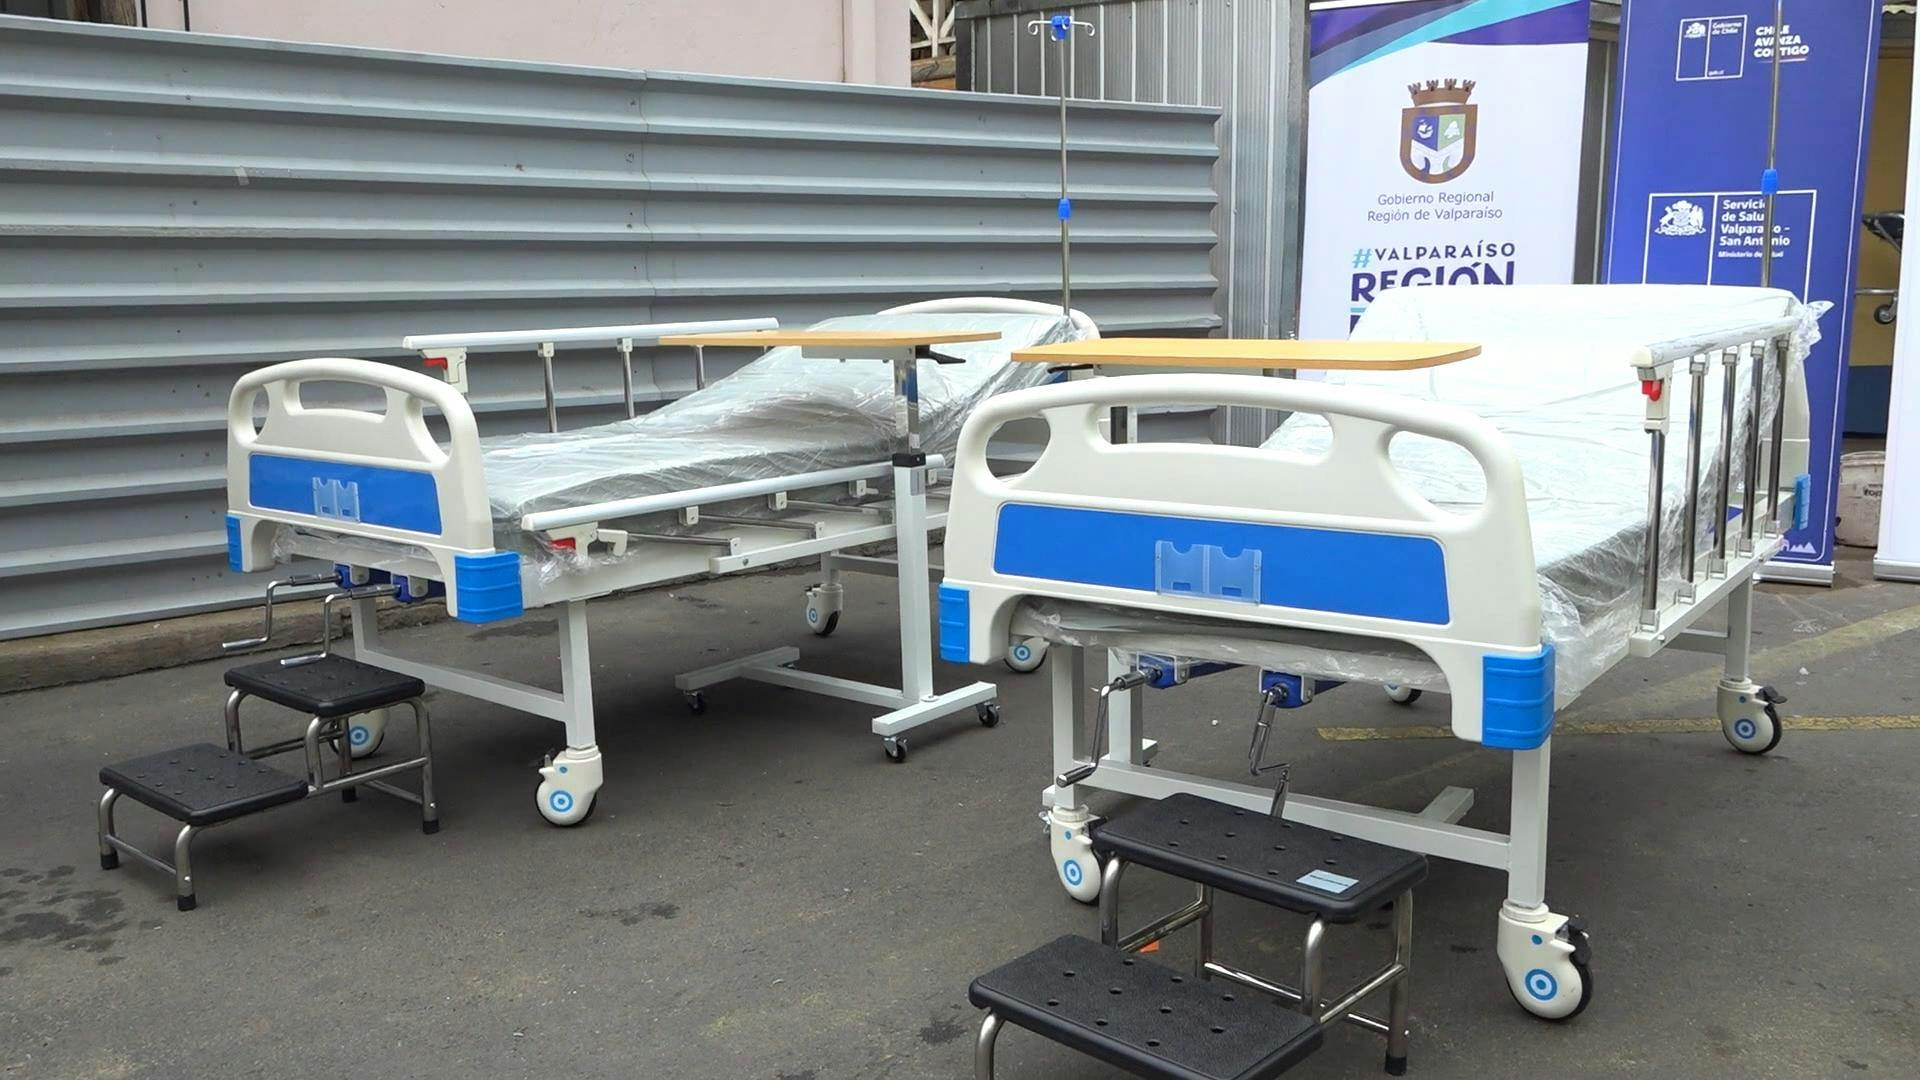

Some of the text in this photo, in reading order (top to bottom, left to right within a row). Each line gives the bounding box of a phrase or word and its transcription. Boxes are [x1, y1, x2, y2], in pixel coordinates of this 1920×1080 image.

[1378, 191, 1494, 206] Gobierno Regional
[1722, 199, 1766, 210] Servici
[1367, 206, 1503, 224] Región de Valparaíso
[1721, 211, 1765, 222] de Salu
[1720, 223, 1782, 236] Valparao
[1719, 235, 1791, 246] San Antnio
[1352, 240, 1516, 269] #VALPARAÍSO
